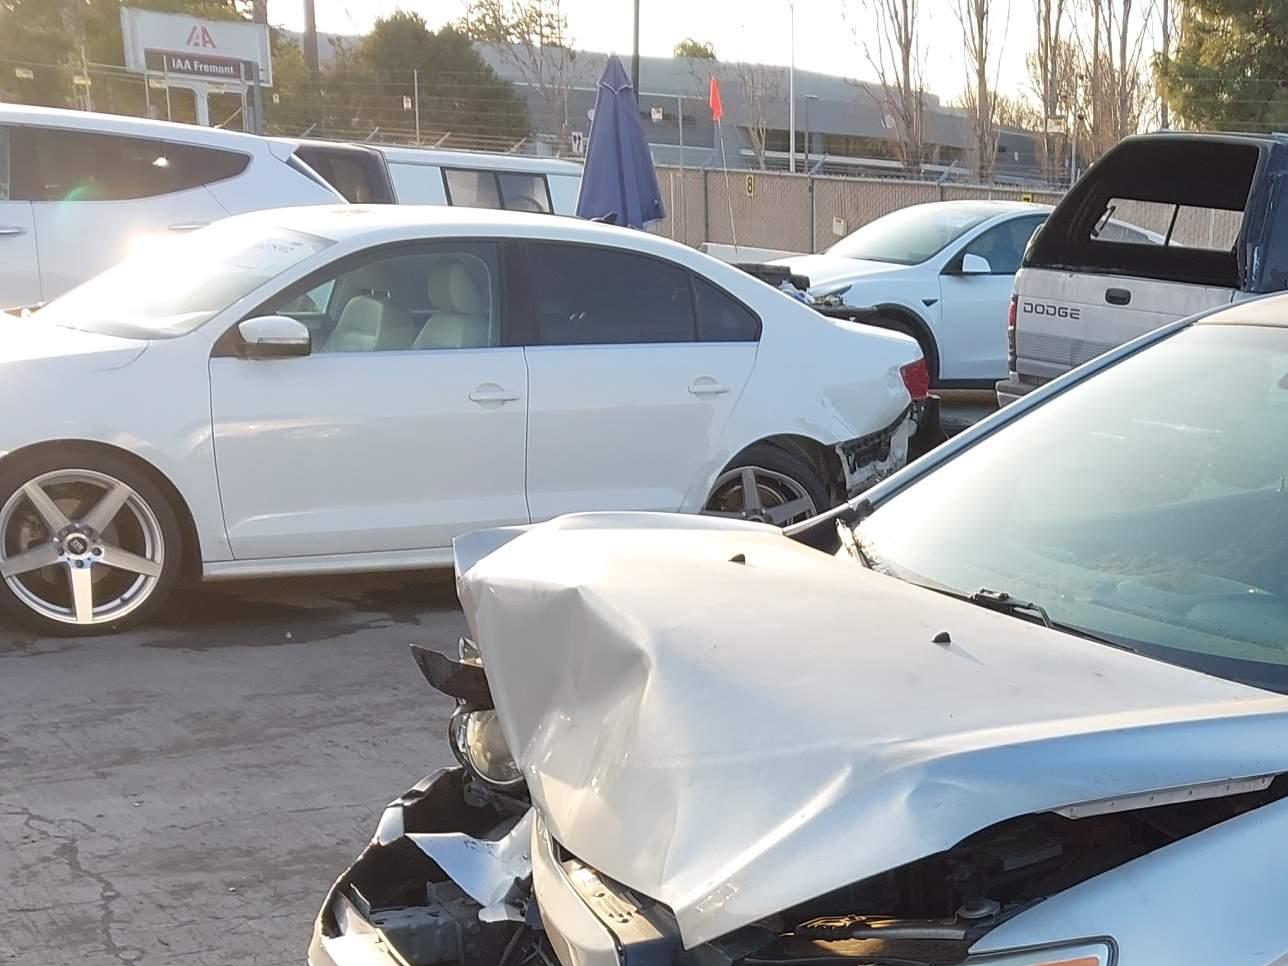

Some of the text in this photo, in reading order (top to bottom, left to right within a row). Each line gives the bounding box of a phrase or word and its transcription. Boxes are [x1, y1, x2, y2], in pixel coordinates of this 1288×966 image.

[172, 58, 234, 74] IAA Fremont
[747, 176, 753, 193] 8
[1023, 302, 1081, 320] DODGE
